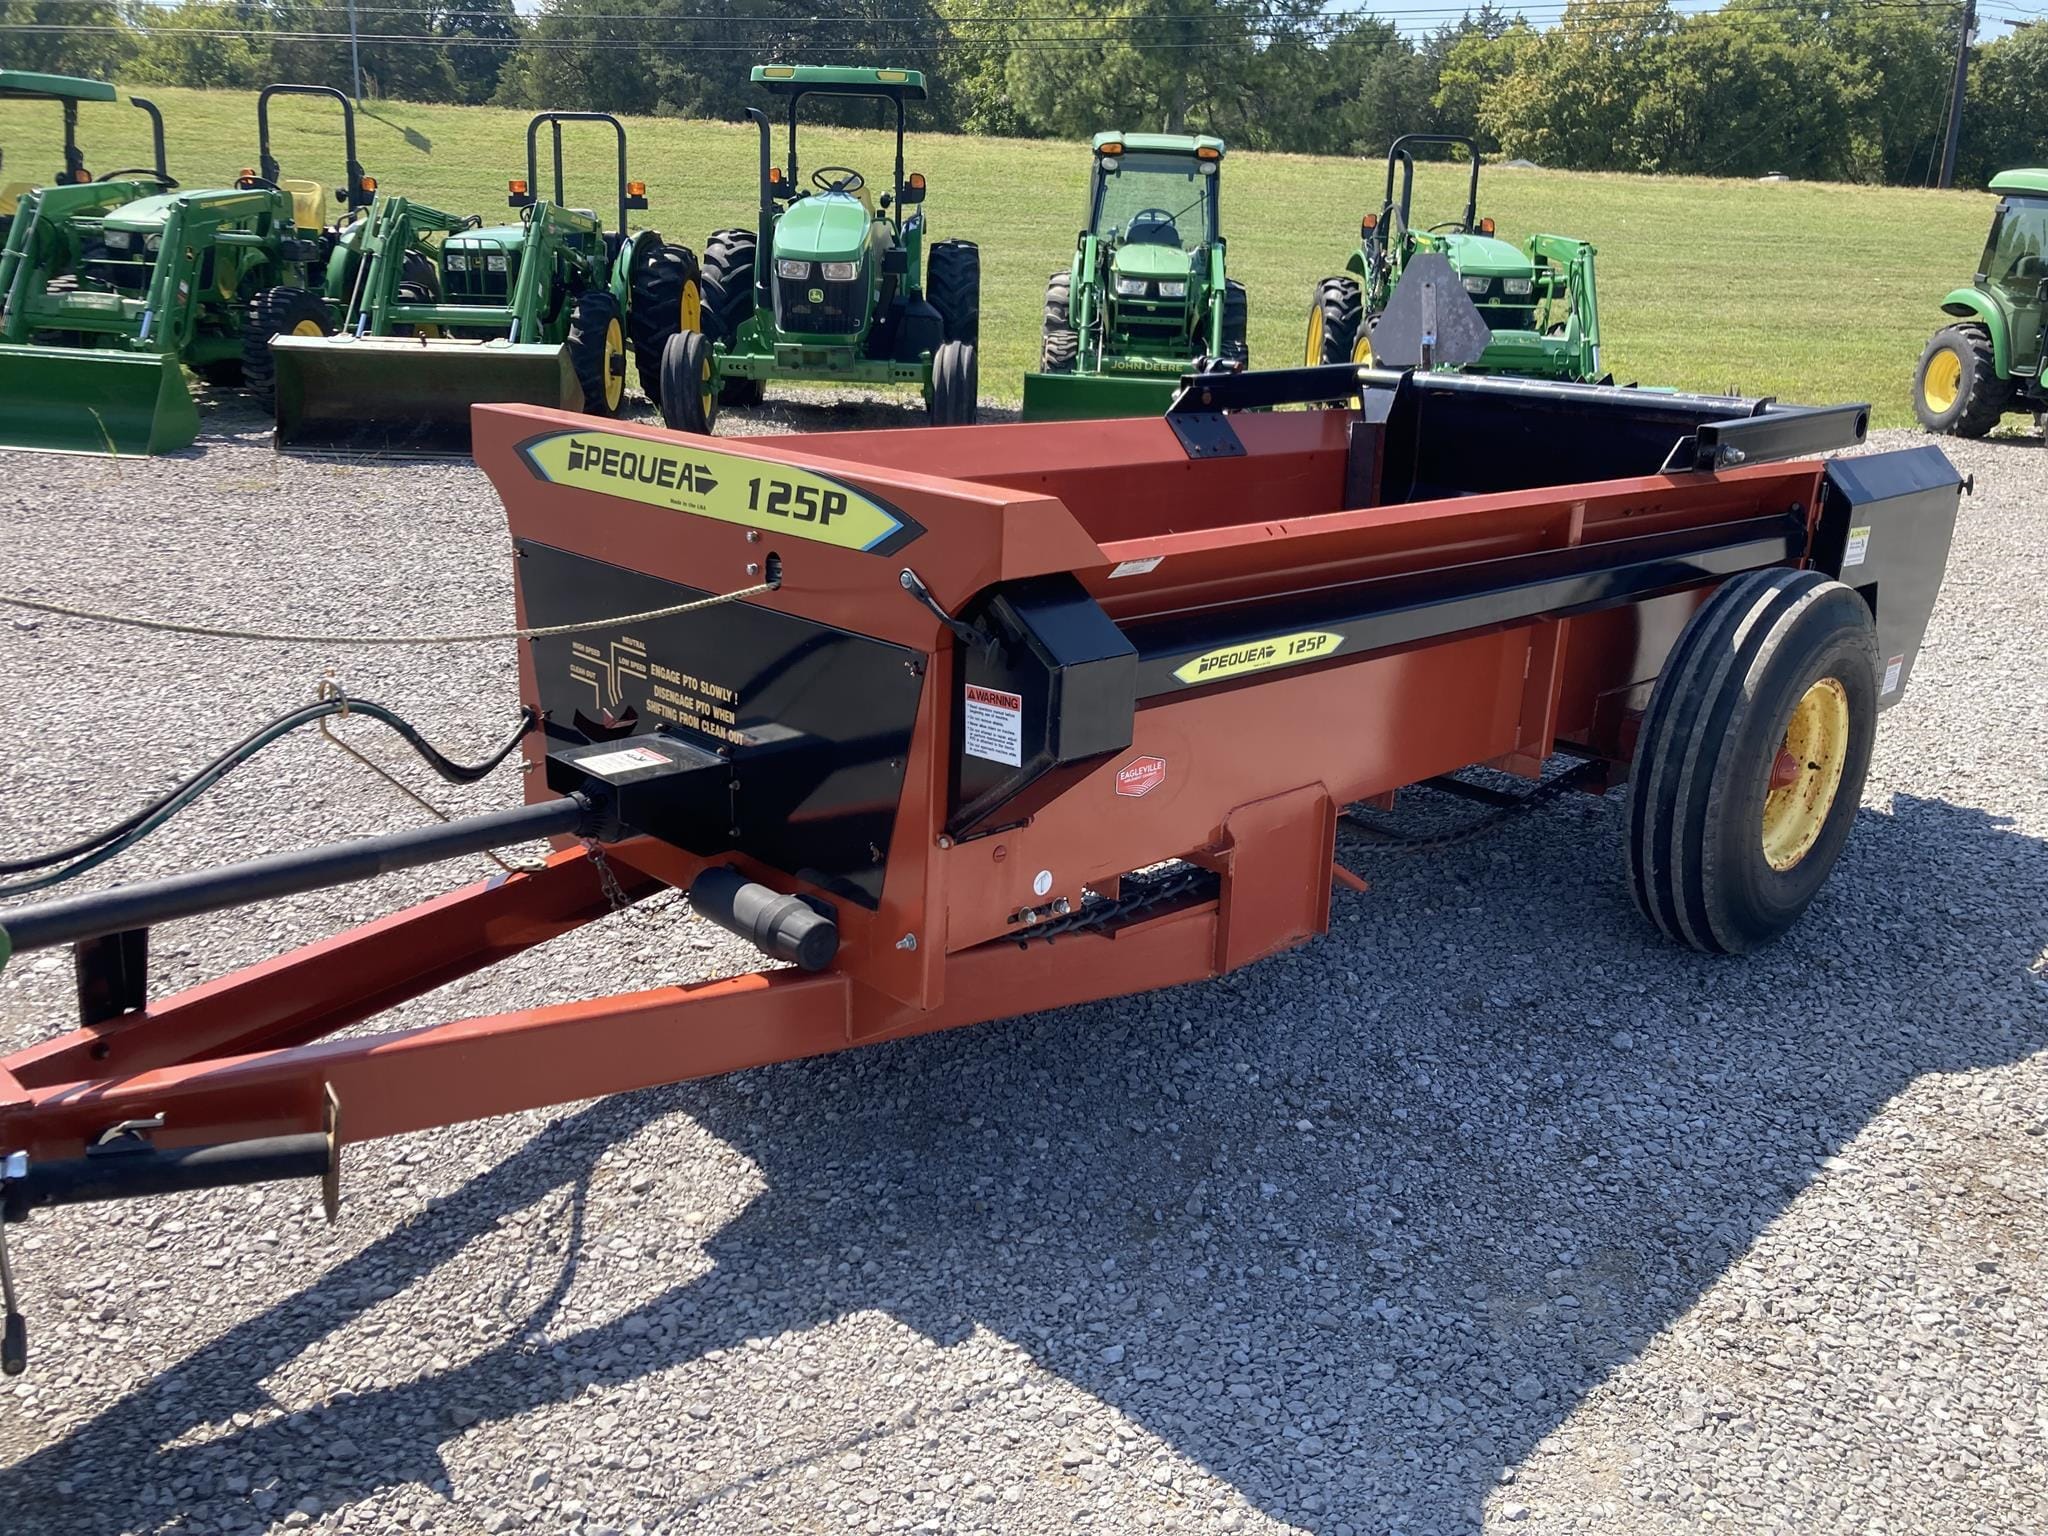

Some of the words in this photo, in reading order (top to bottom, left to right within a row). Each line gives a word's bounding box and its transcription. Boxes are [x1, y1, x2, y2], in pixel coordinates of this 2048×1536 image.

[1110, 360, 1142, 370] JOHN
[1145, 361, 1184, 372] DEERE
[583, 446, 695, 493] PEQUEA
[748, 477, 849, 526] 125P
[585, 646, 601, 657] SPEED
[622, 635, 647, 650] NEUTRAL
[1208, 647, 1266, 671] PEQUEA
[1288, 635, 1327, 656] 125P
[569, 664, 586, 676] CLEAN
[586, 669, 597, 680] OUT
[618, 656, 630, 666] LOW
[630, 660, 647, 672] SPEED
[650, 663, 681, 685] ENGAGE
[682, 674, 698, 691] PTO
[700, 680, 732, 703] SLOWLY
[653, 685, 694, 710] DISENGAGE
[695, 699, 710, 716] PTO
[712, 705, 735, 725] WHEN
[975, 690, 1018, 709] WARNING
[646, 699, 677, 721] SHIFTING
[679, 711, 700, 730] FROM
[701, 720, 726, 740] CLEAN
[728, 729, 744, 746] OUT
[1120, 761, 1162, 781] EAGLEVILLE
